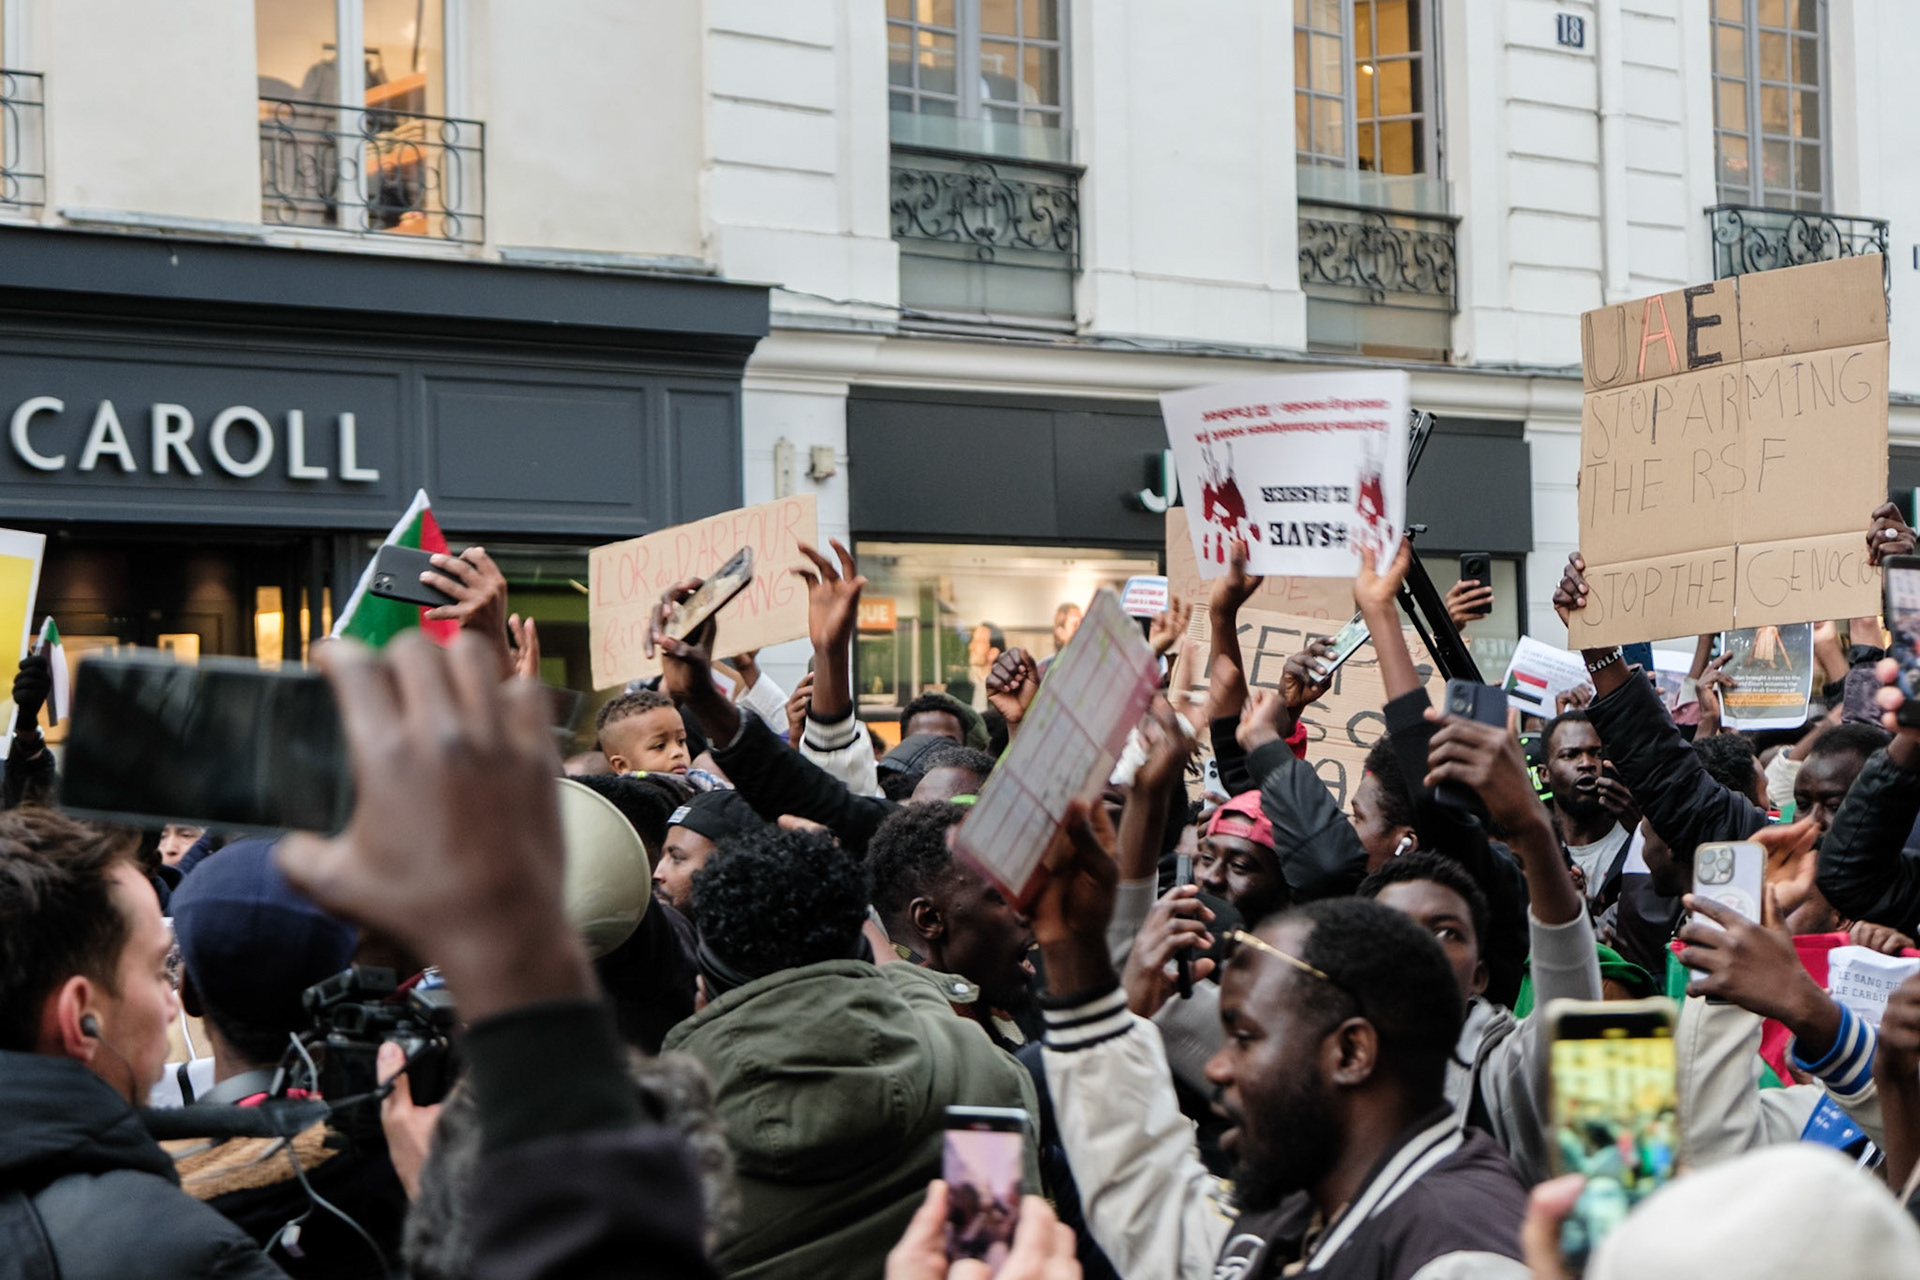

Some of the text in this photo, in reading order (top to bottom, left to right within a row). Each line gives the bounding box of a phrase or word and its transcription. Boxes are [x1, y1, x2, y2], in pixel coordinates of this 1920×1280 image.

[1559, 14, 1581, 45] 18
[1586, 283, 1722, 388] UAE
[10, 396, 380, 482] CAROLL
[1592, 352, 1872, 459] STOP ARMING
[1587, 438, 1786, 528] THE RSF
[675, 501, 802, 579] DARFOUR
[1269, 521, 1348, 548] #SAVE
[1581, 566, 1662, 626] STOP
[1746, 547, 1882, 608] GENOCID
[1835, 986, 1887, 1003] LE CARBU
[1838, 971, 1851, 981] LE
[1854, 973, 1882, 988] SANG
